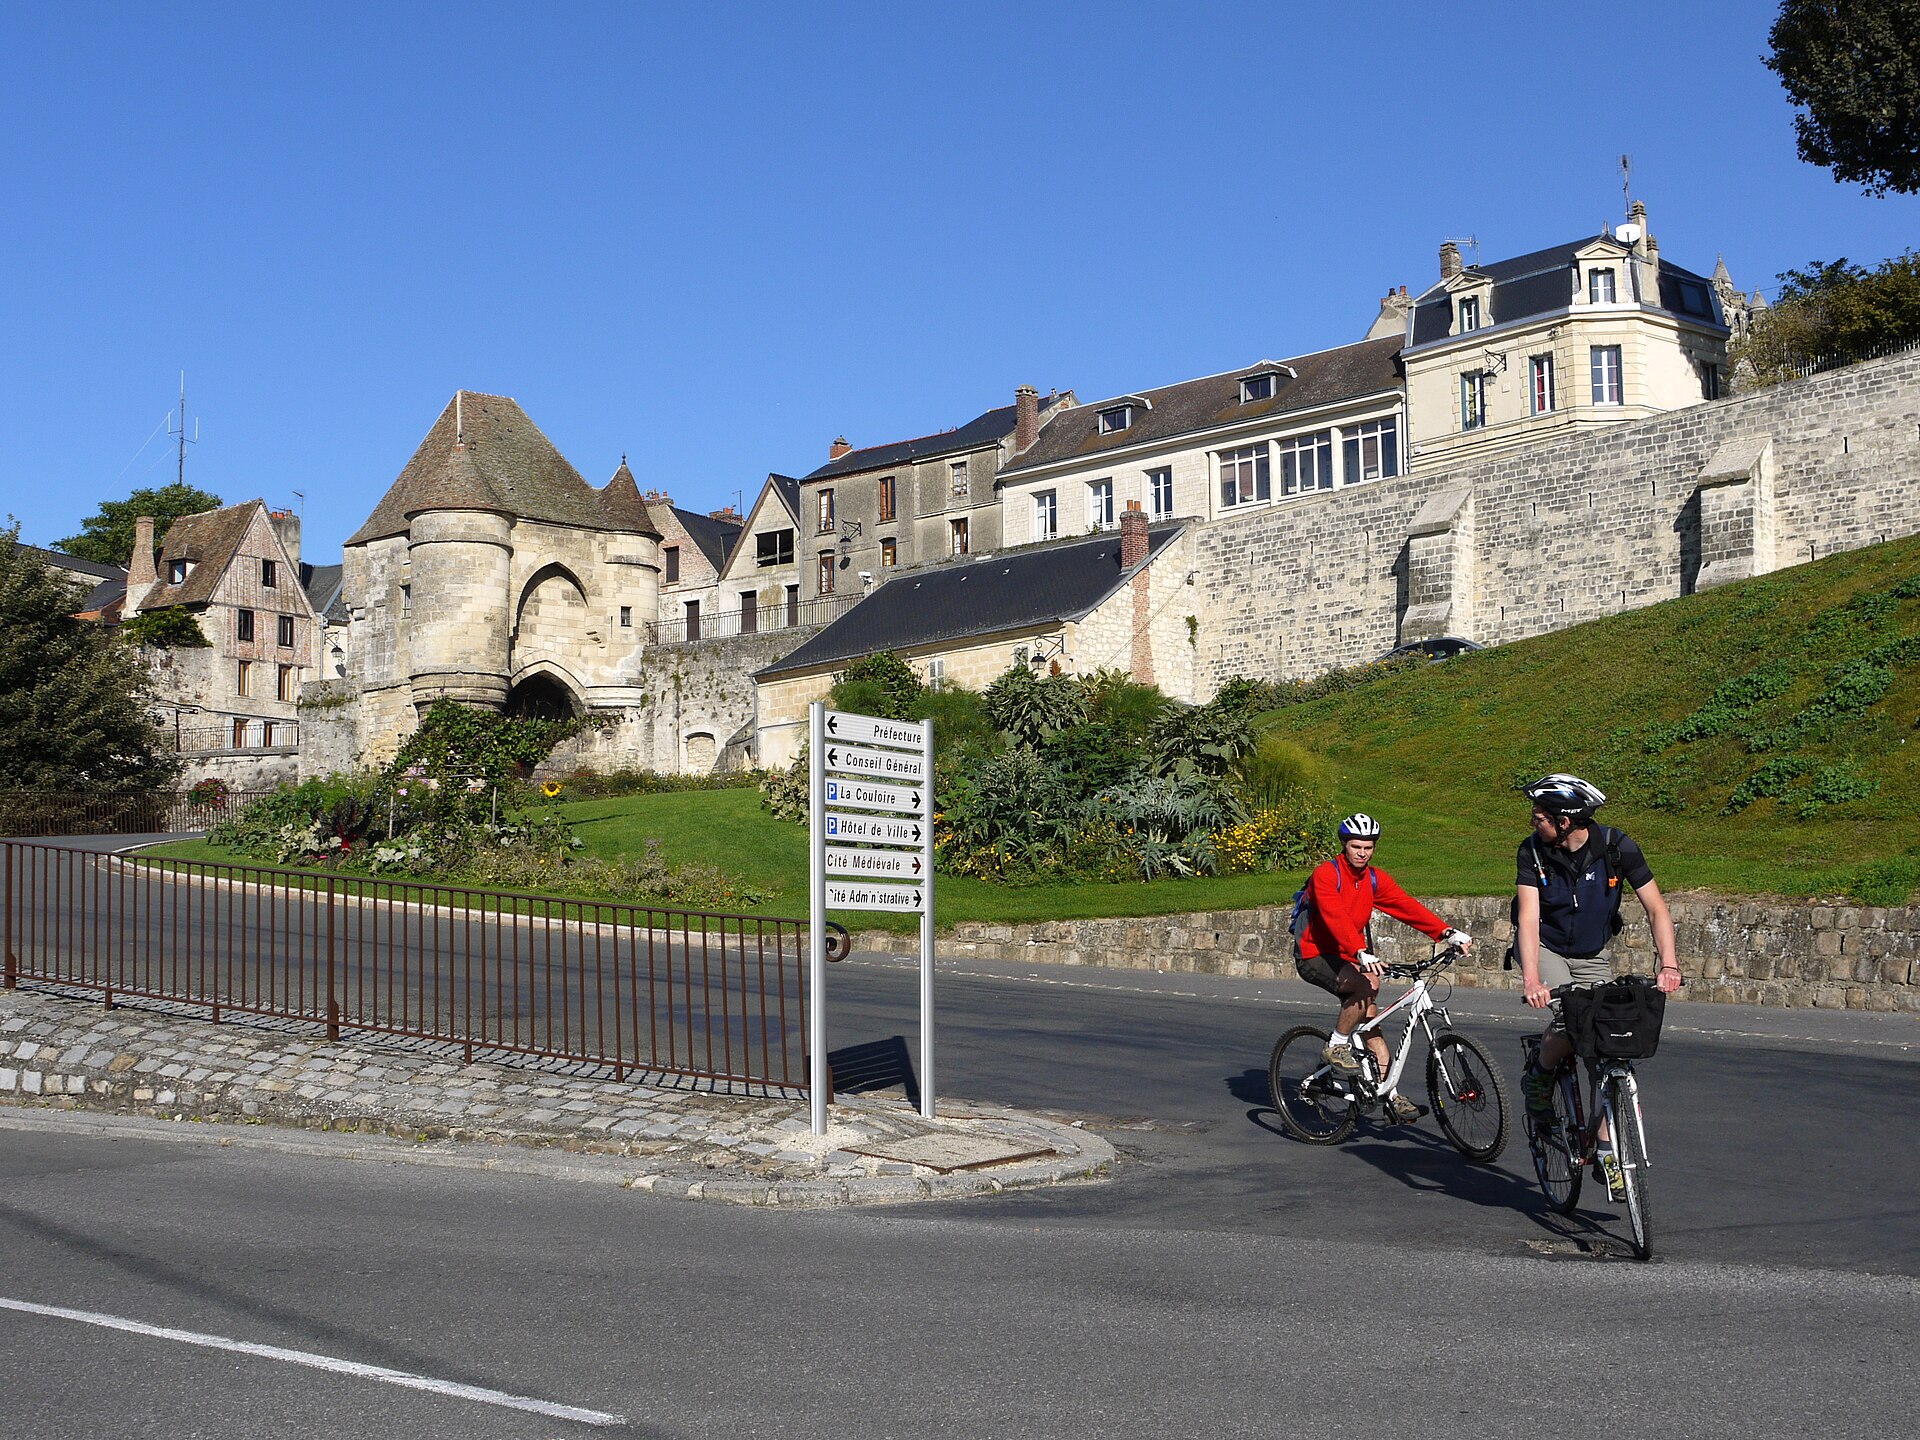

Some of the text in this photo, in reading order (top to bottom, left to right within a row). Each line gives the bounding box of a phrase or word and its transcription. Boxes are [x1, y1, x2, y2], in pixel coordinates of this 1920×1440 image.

[873, 725, 922, 744] Préfecture
[846, 753, 922, 775] Conseil Général
[828, 784, 896, 805] P La Couloire
[828, 819, 909, 839] P Hôtel de Ville
[827, 854, 901, 871] Cité Médiévale
[829, 888, 910, 905] ité Admnstrative
